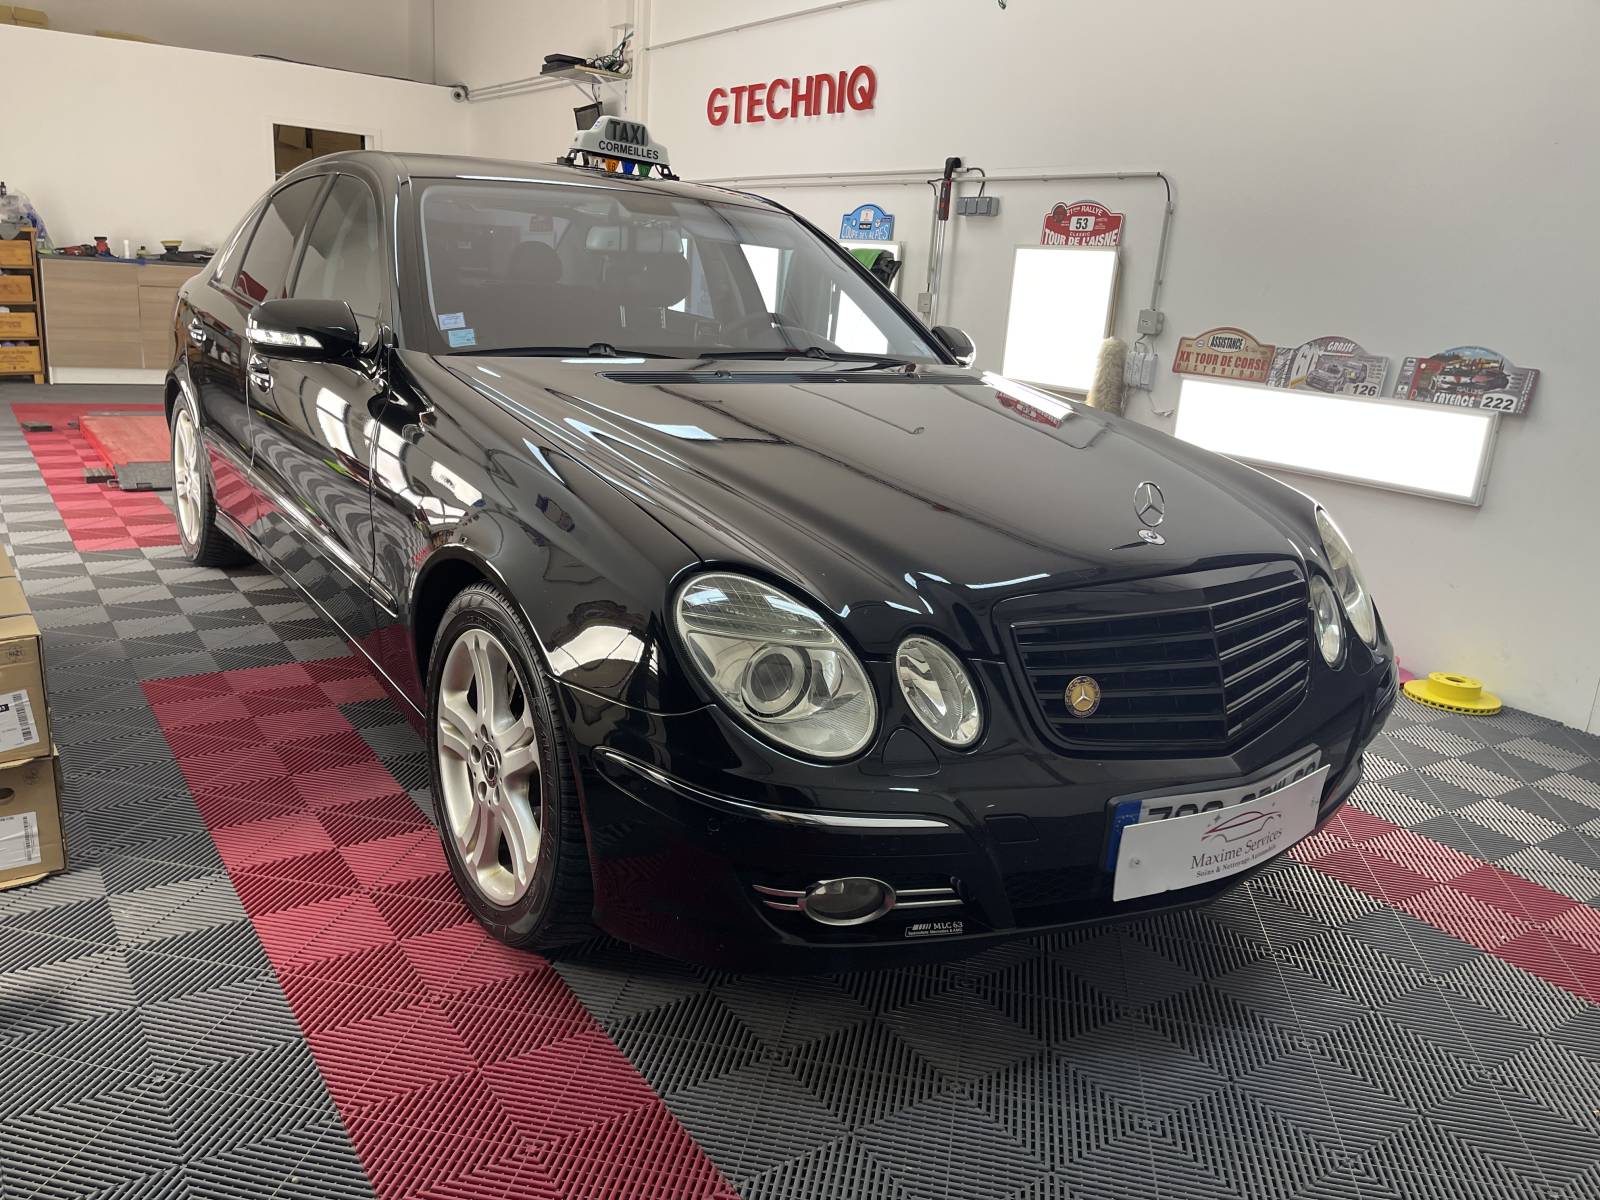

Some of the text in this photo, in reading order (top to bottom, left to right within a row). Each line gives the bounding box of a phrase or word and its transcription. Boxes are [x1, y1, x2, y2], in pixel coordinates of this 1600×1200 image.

[707, 65, 877, 126] GTECHNIQ
[609, 121, 646, 145] TAXI
[598, 140, 659, 160] CORMEILLES
[1081, 205, 1103, 217] RALLYE
[1075, 217, 1089, 230] 53
[1044, 228, 1119, 246] TOUR DE L'AISNE
[1210, 335, 1243, 350] ASSISTANCE
[1195, 352, 1219, 365] TOUR
[1220, 355, 1233, 368] DE
[1234, 357, 1267, 371] CORSE
[1352, 383, 1377, 397] 126
[1433, 391, 1475, 408] FAYENCE
[1482, 396, 1514, 411] 222
[1190, 828, 1283, 870] Maxime Services
[1196, 869, 1214, 878] Soins
[933, 922, 952, 930] MLC
